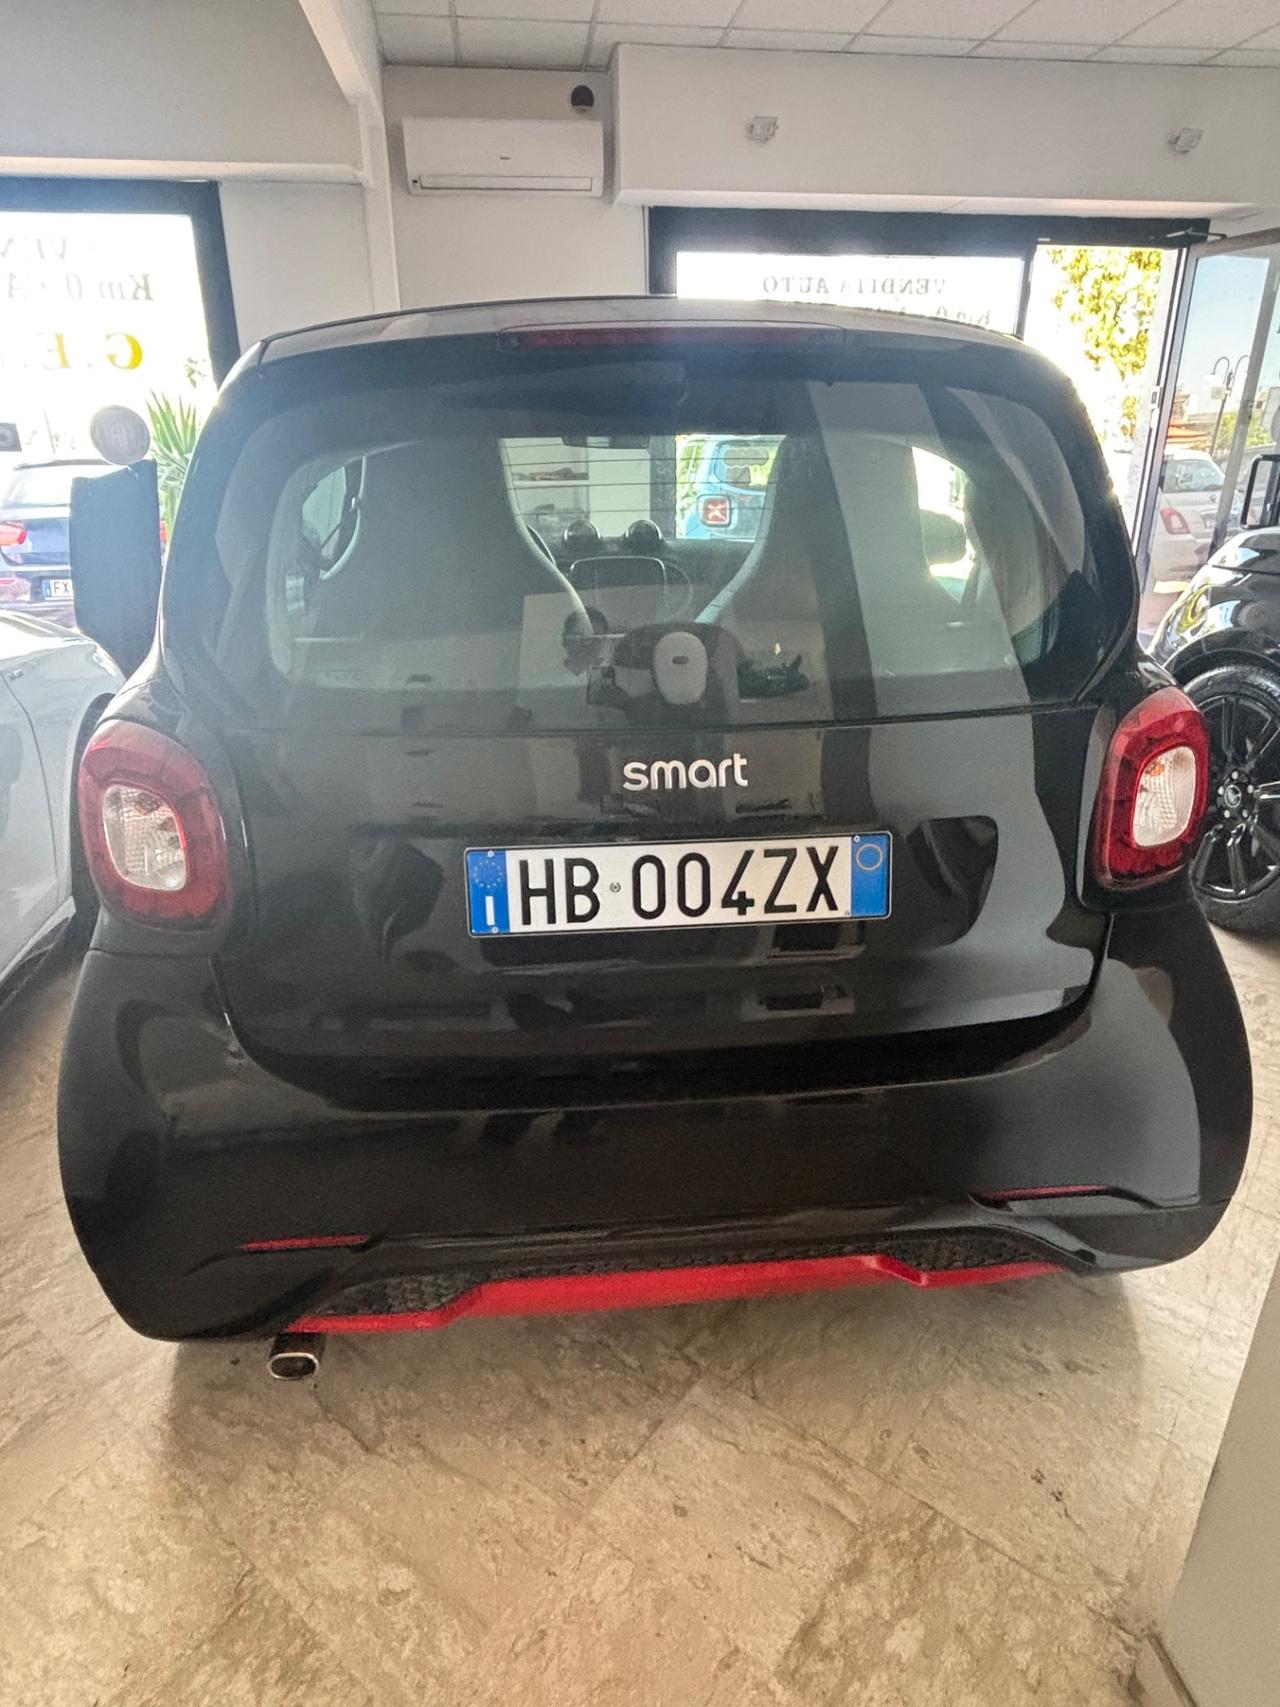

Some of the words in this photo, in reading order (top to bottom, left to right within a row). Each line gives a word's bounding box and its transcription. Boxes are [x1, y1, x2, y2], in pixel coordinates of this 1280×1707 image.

[622, 753, 749, 791] smart
[518, 856, 600, 926] HB
[631, 845, 840, 920] 004ZX
